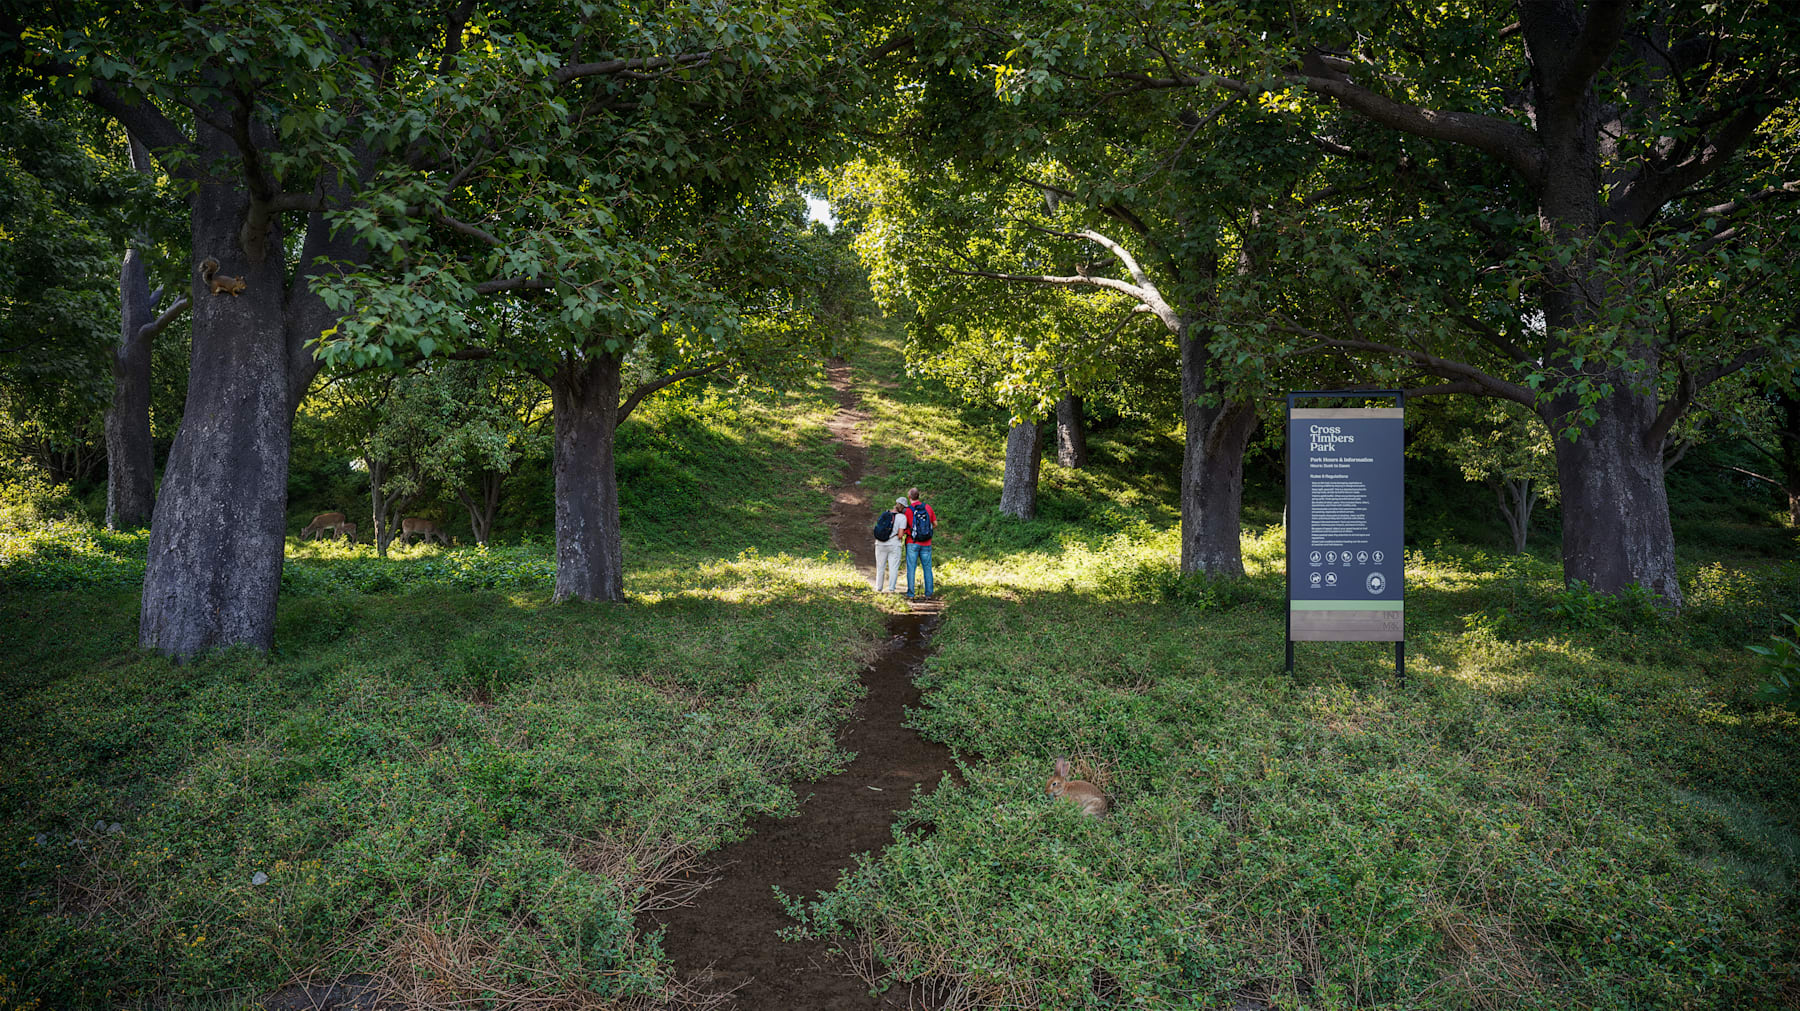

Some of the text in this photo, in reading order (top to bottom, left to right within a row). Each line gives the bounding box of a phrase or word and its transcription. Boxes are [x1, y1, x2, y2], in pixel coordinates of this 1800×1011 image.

[1310, 424, 1341, 434] Cross
[1310, 433, 1354, 443] Timbers
[1310, 442, 1336, 451] Park
